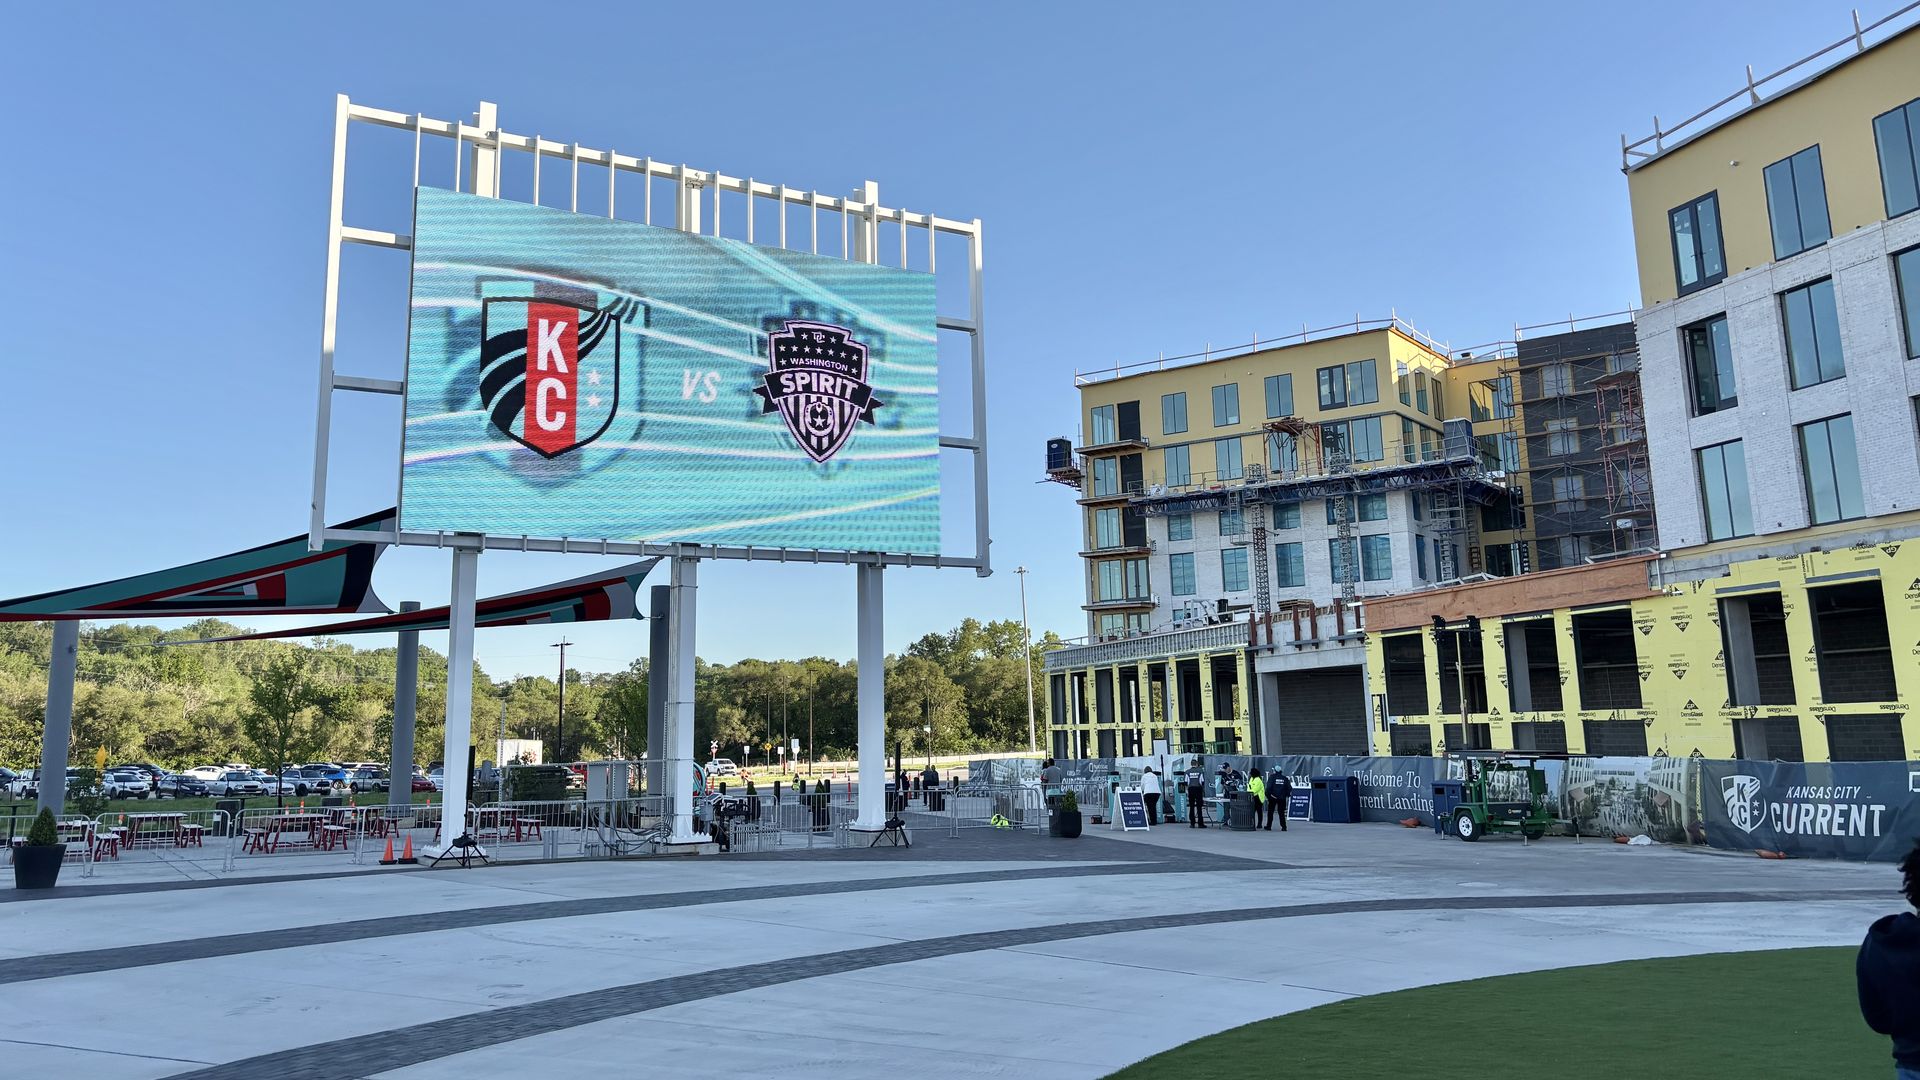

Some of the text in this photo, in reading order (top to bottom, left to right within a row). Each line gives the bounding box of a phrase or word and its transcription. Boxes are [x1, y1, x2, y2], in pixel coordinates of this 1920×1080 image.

[789, 357, 849, 372] WASHINGTON
[681, 368, 722, 404] VS
[780, 372, 859, 400] SPIRIT
[1353, 769, 1421, 789] Welcome To
[1785, 786, 1862, 799] KANSAS CITY
[1387, 793, 1435, 817] Landing
[1770, 802, 1886, 837] CURRENT
